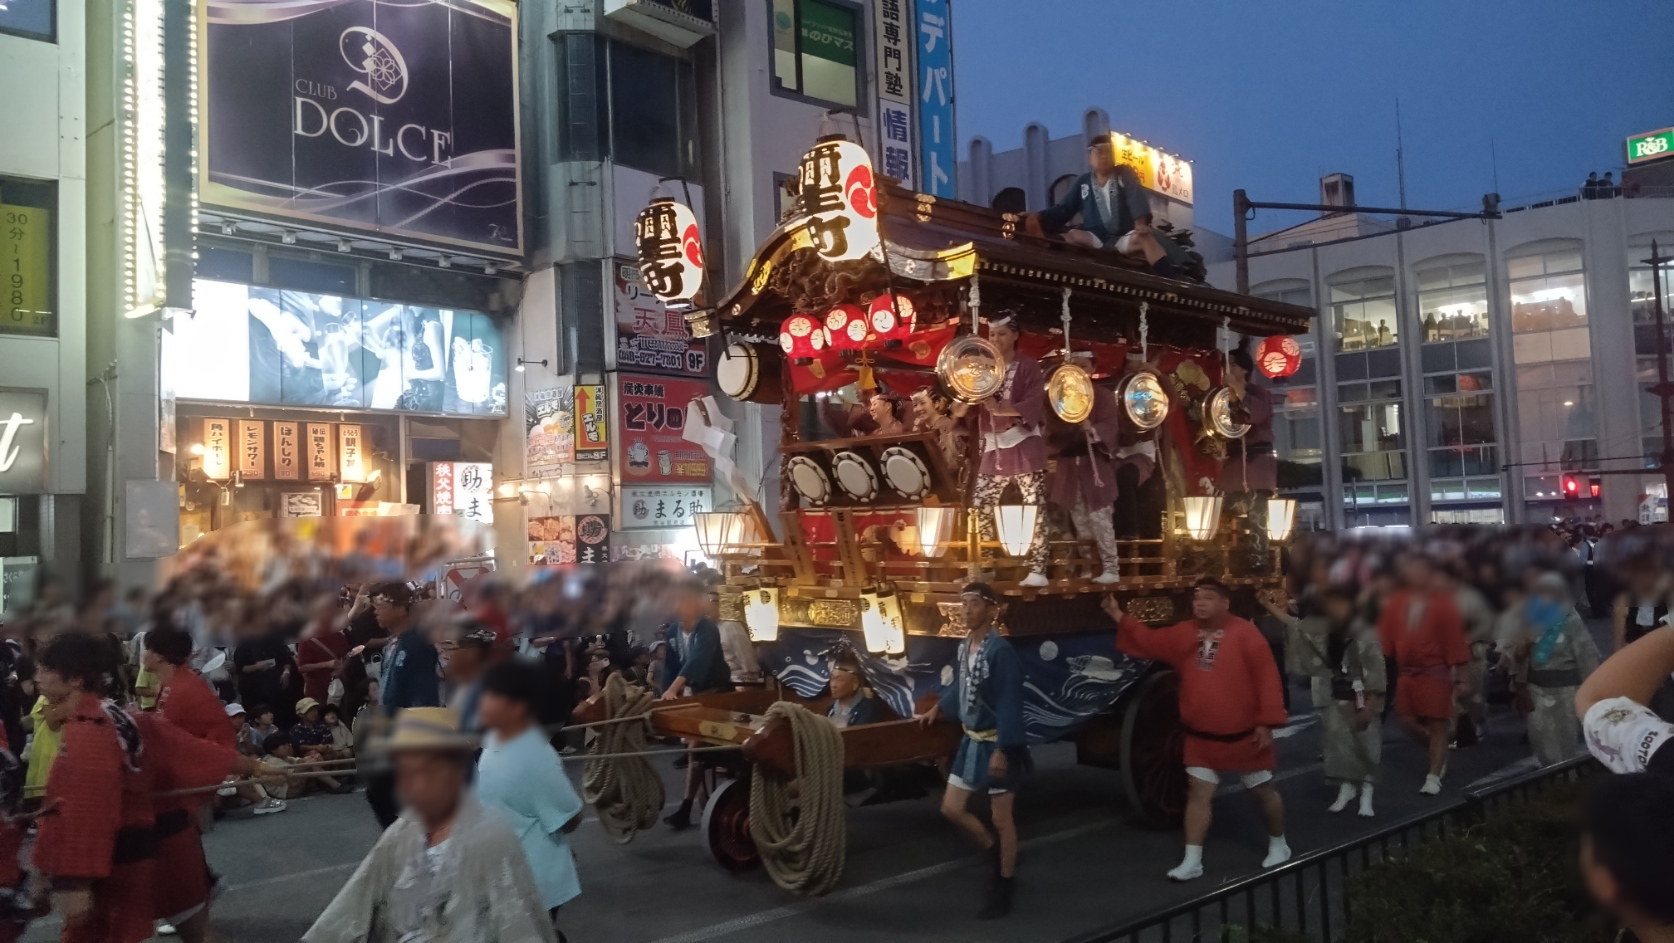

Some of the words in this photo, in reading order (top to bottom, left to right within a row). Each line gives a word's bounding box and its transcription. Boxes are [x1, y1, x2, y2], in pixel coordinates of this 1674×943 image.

[295, 79, 338, 100] CLUB
[922, 0, 949, 195] デパート
[294, 96, 452, 170] DOLCE
[883, 108, 910, 182] 情報
[1636, 138, 1668, 157] R&B
[687, 351, 704, 369] 9F
[623, 402, 688, 431] とりの
[246, 426, 259, 467] レモンサワー
[654, 500, 703, 518] まる助
